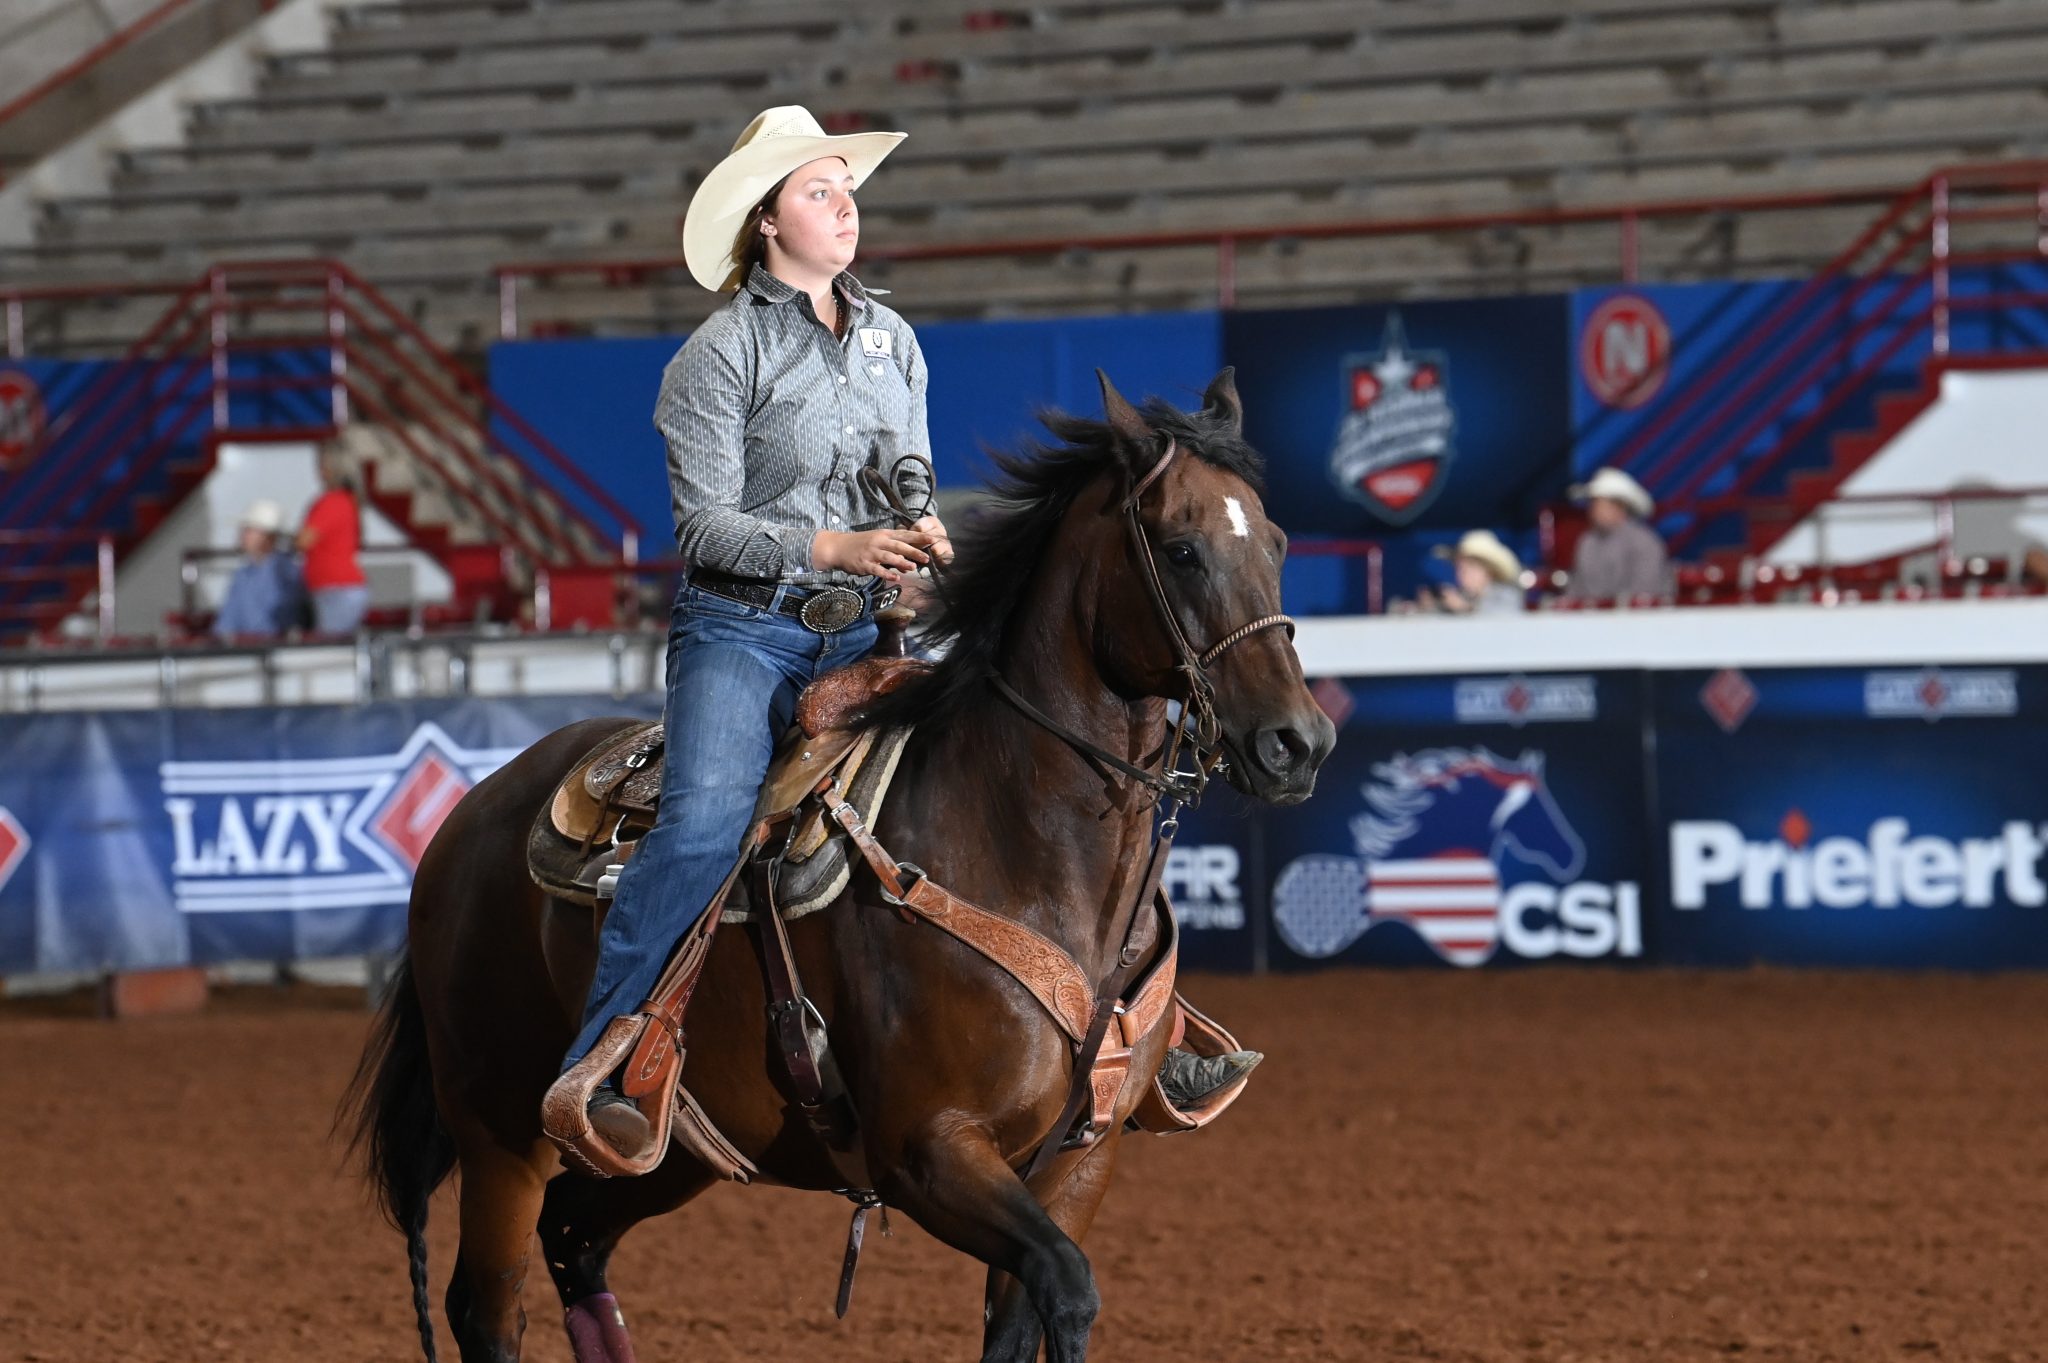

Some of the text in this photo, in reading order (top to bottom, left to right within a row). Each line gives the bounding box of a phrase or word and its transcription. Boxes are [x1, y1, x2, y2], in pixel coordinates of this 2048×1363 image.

[1604, 322, 1648, 375] N
[164, 795, 352, 875] LAZY
[1669, 814, 2046, 908] Priefert
[1501, 881, 1641, 958] CSI
